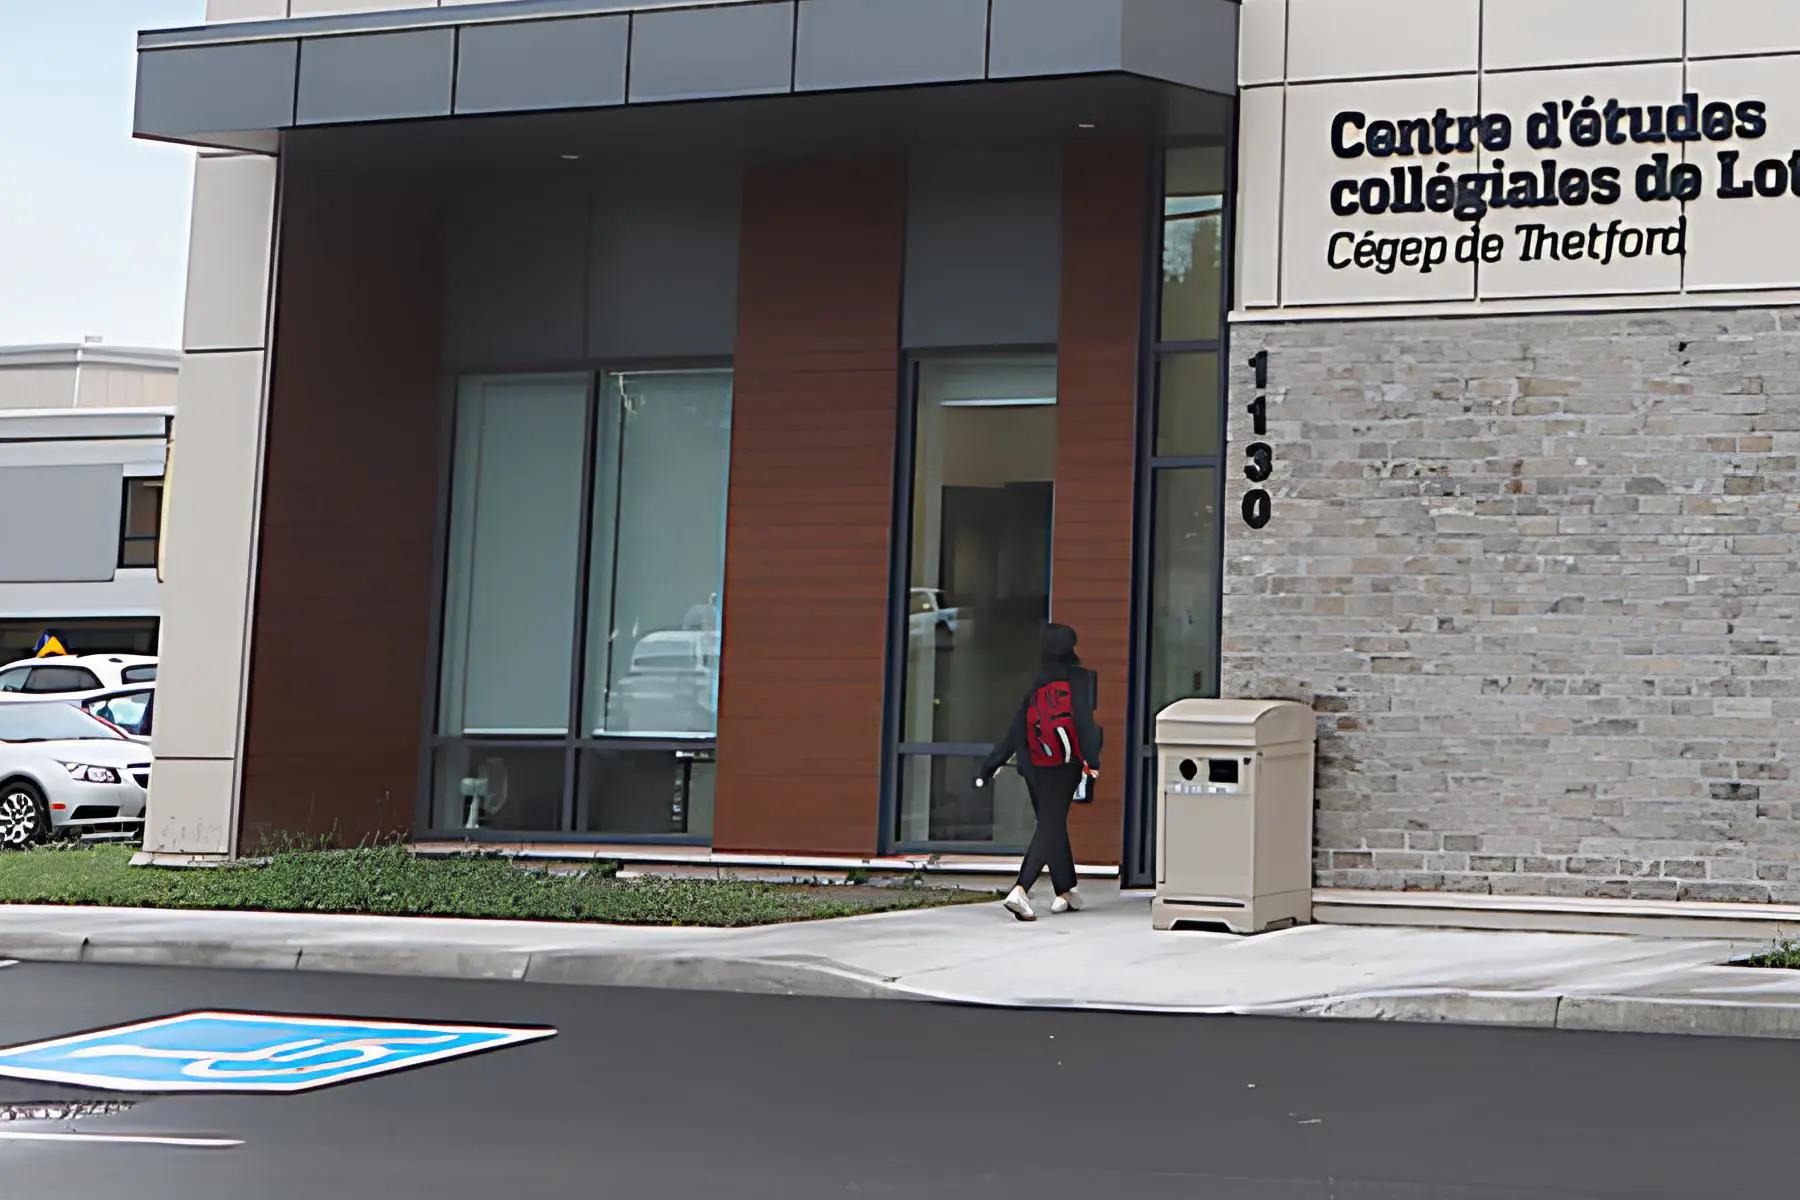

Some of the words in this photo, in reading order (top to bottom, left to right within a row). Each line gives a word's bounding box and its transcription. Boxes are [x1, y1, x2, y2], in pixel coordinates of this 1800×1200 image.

[1331, 108, 1512, 158] Centre
[1526, 93, 1767, 150] d'études
[1330, 158, 1621, 221] collégiales
[1635, 153, 1701, 201] de
[1327, 230, 1447, 274] Cégep
[1455, 224, 1504, 263] de
[1514, 215, 1687, 265] Thetford
[1241, 350, 1273, 529] 1130
